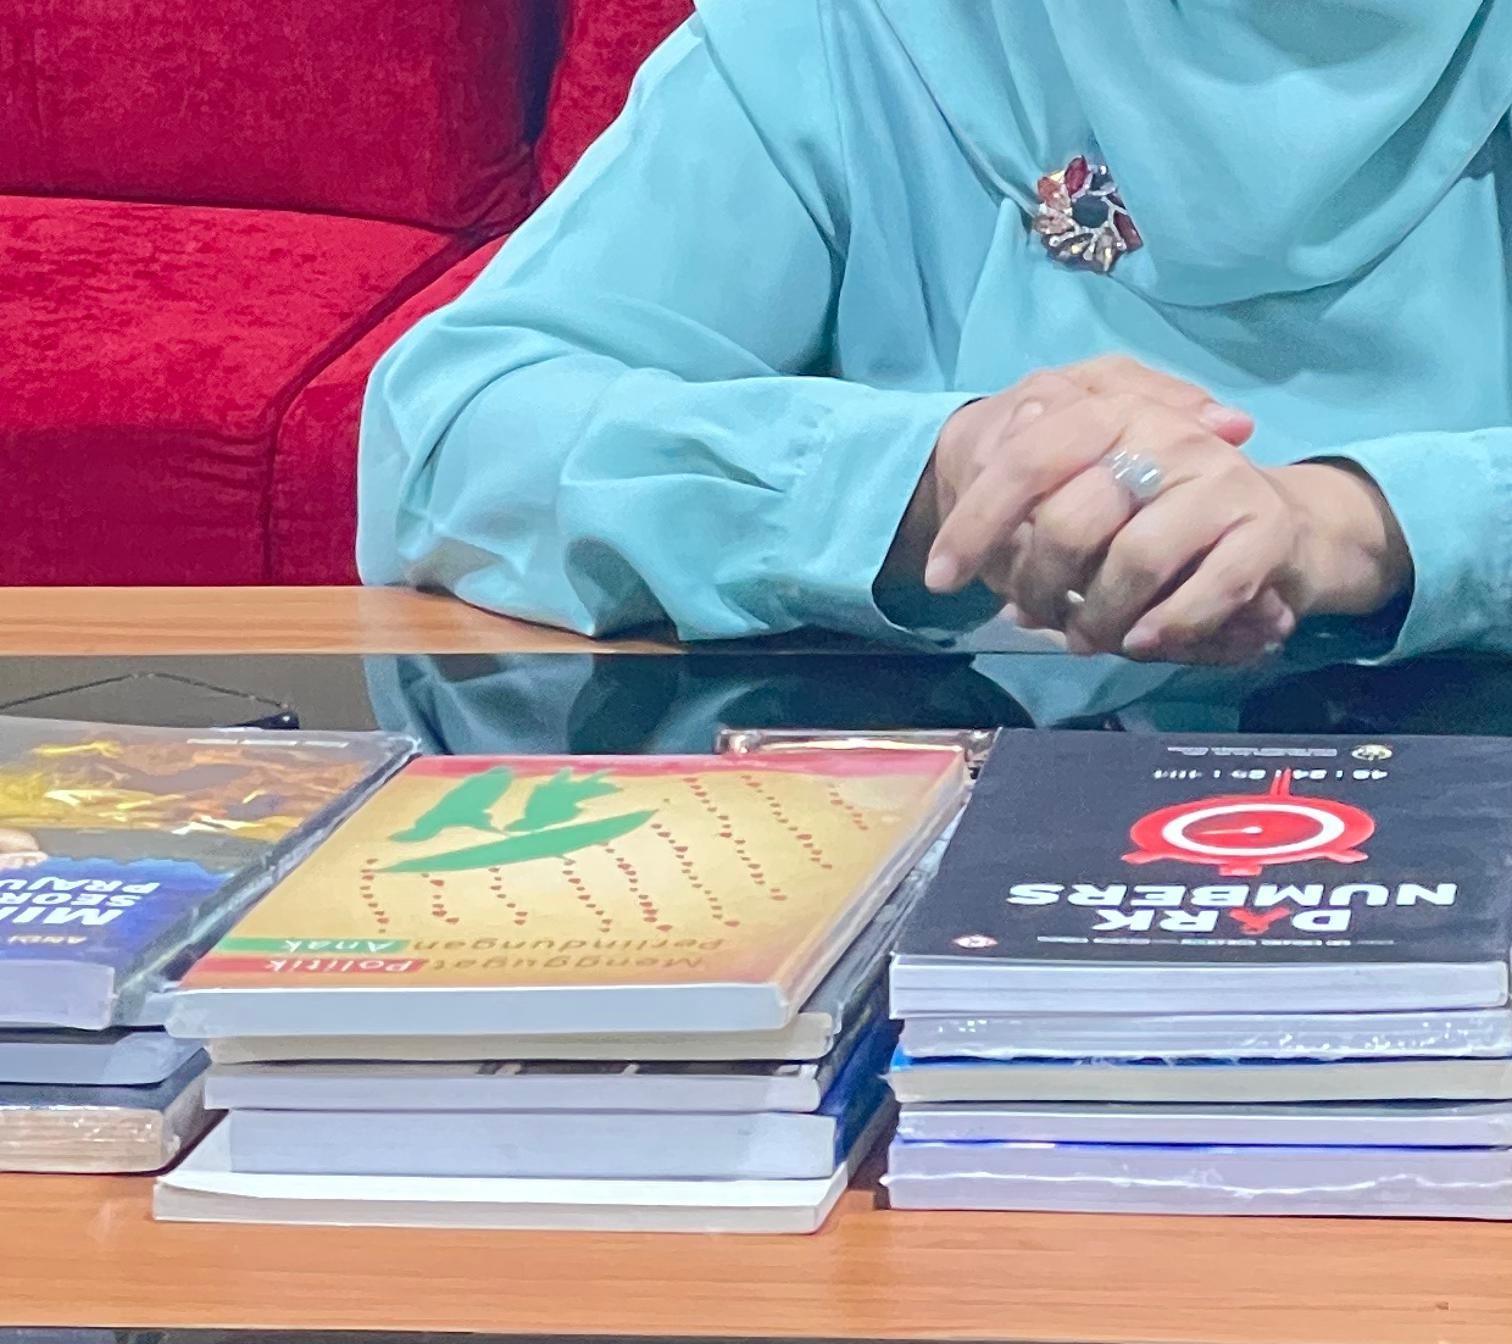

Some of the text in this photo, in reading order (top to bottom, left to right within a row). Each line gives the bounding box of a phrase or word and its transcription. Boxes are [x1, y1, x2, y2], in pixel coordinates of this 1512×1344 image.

[1006, 882, 1459, 906] NUMBERS
[0, 906, 124, 926] MI
[1092, 908, 1353, 935] DARK
[283, 937, 726, 953] Perlindungan Anak
[264, 954, 704, 973] Menggugat Politik
